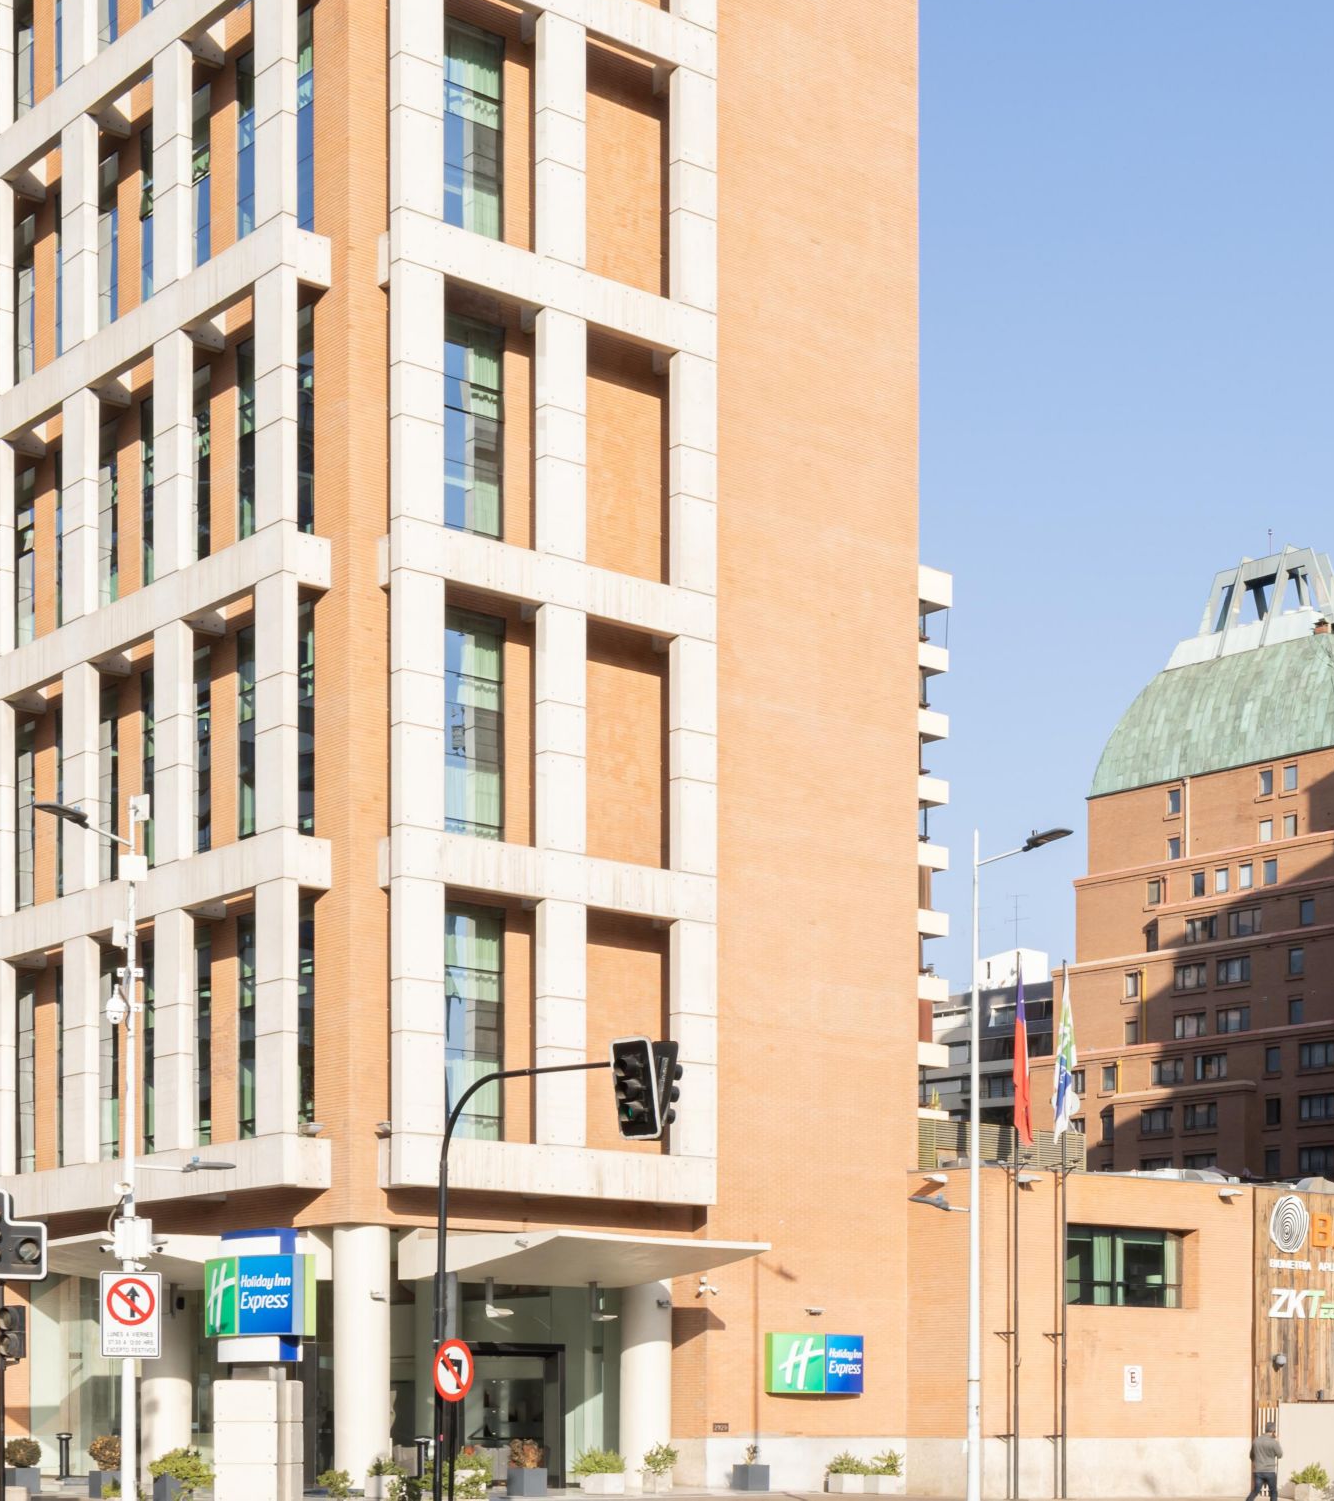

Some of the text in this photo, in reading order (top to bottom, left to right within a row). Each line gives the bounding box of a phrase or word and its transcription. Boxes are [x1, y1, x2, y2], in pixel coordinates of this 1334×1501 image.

[240, 1273, 291, 1290] Holiday Inn
[240, 1291, 289, 1314] Express
[828, 1347, 854, 1361] Holiday
[828, 1360, 862, 1377] Express
